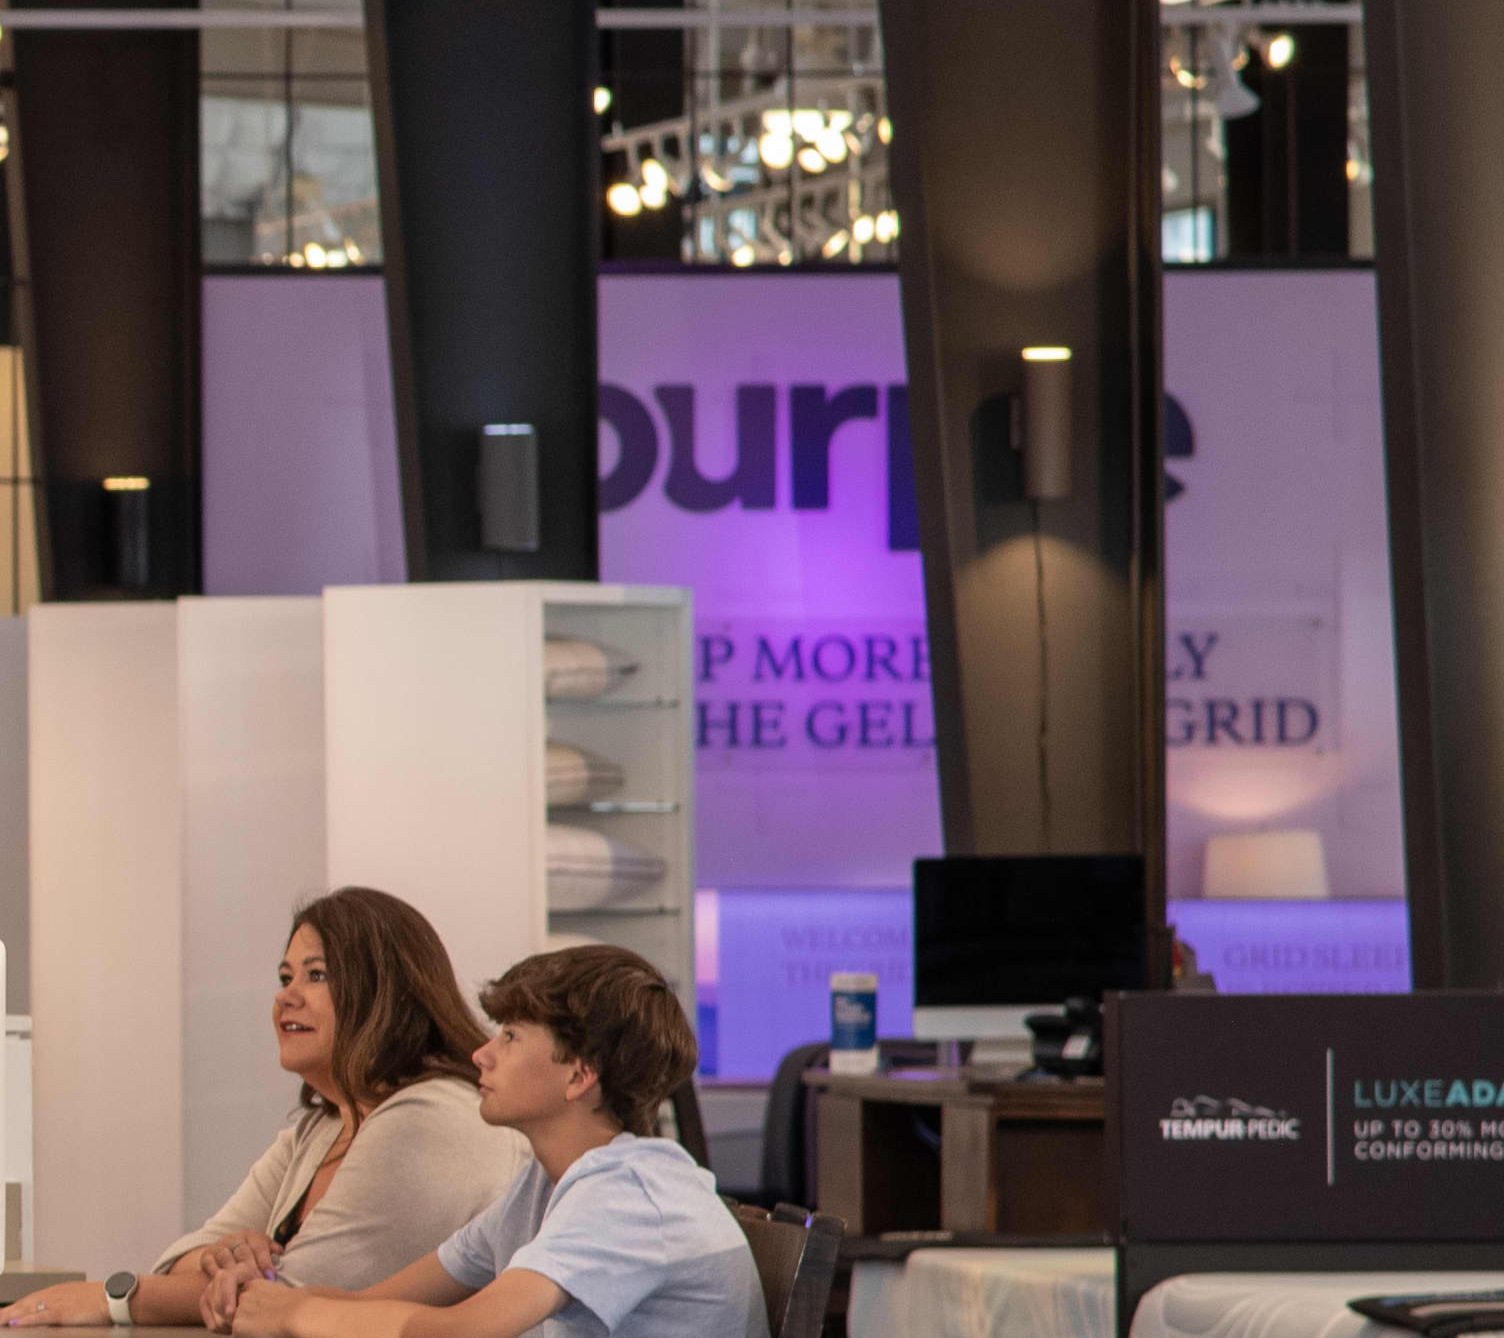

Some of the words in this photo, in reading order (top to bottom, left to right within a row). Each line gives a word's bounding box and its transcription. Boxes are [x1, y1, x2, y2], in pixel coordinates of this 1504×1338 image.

[1353, 1119, 1385, 1139] UP
[1391, 1119, 1422, 1139] TO
[1428, 1119, 1474, 1139] 30%
[1353, 1140, 1504, 1160] CONFORMING
